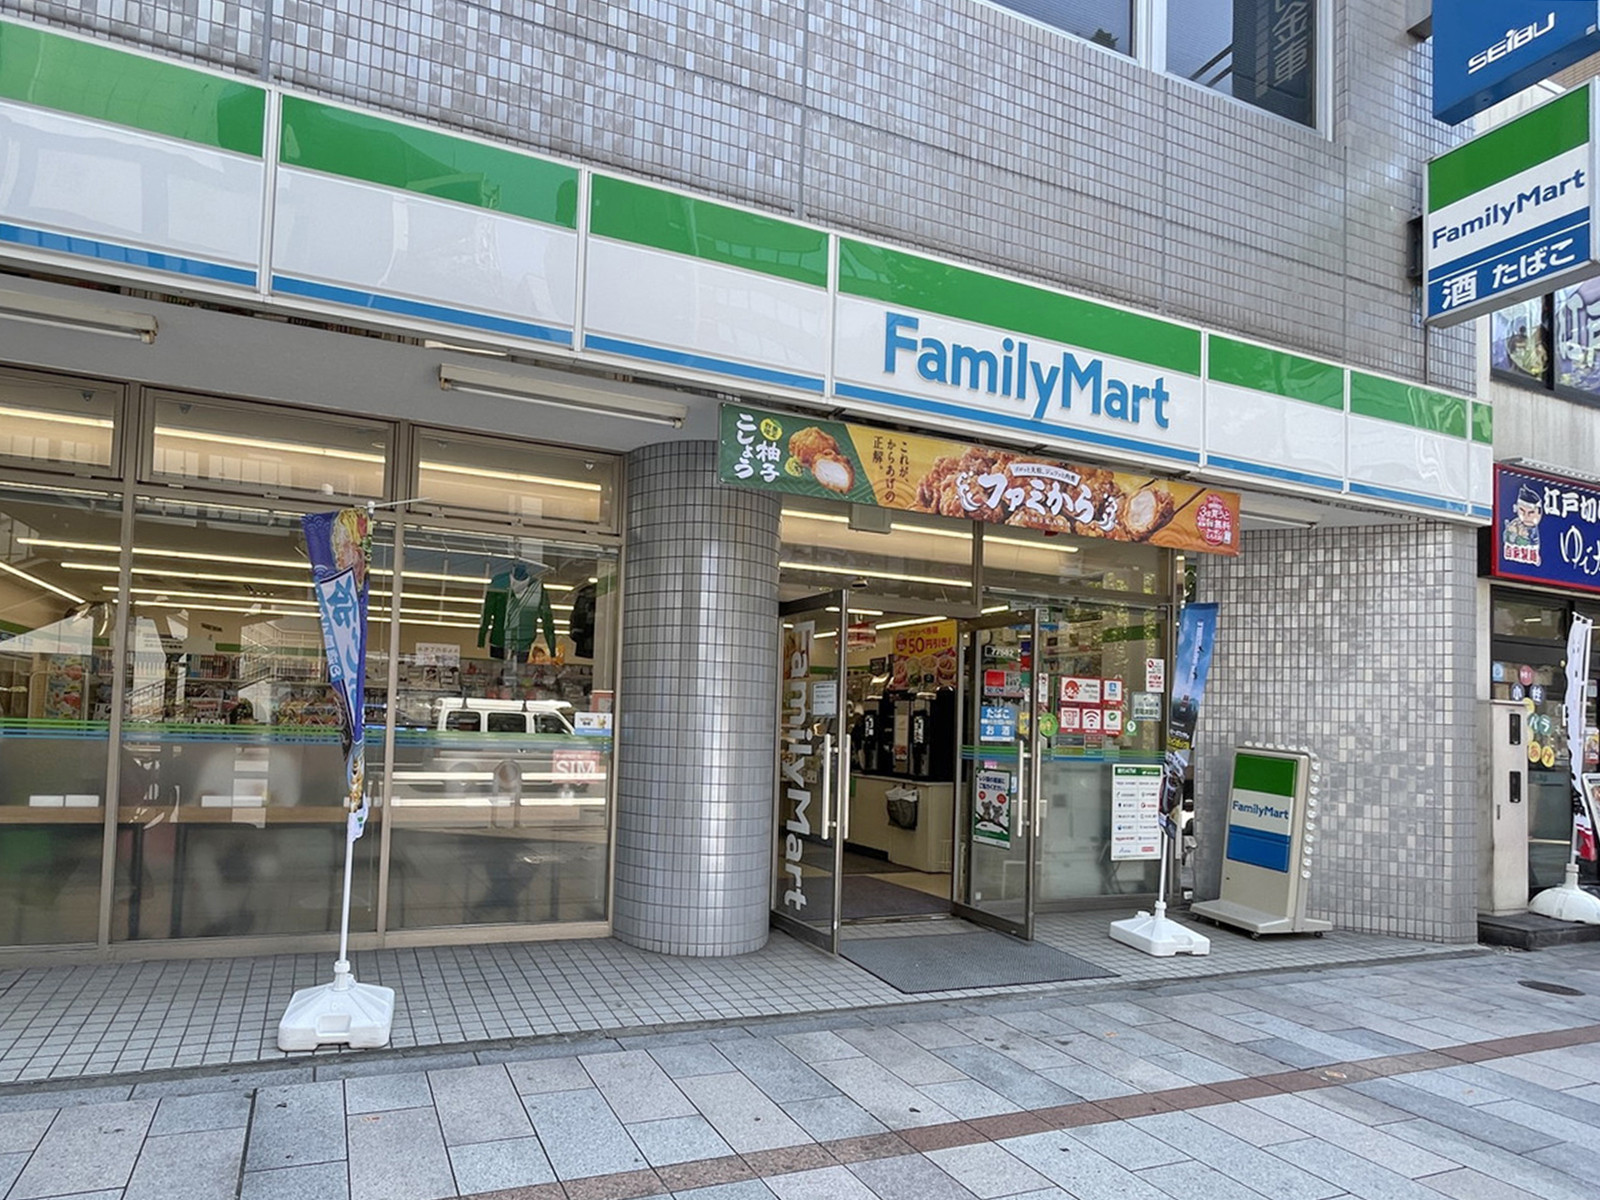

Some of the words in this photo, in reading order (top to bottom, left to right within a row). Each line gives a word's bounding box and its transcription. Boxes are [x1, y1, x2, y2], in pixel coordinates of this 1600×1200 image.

[1432, 168, 1586, 249] FamilyMart
[1441, 270, 1477, 310] 酒
[1492, 238, 1575, 289] たばこ
[883, 311, 1170, 429] FamilyMart
[733, 413, 758, 481] こしょう
[756, 440, 781, 483] 柚子
[885, 438, 896, 503] からあげの
[978, 471, 1095, 524] ファミから
[986, 707, 1010, 719] たばこ
[556, 760, 596, 774] SIM
[782, 620, 816, 911] FamilyMart
[1232, 800, 1289, 820] FamilyMart
